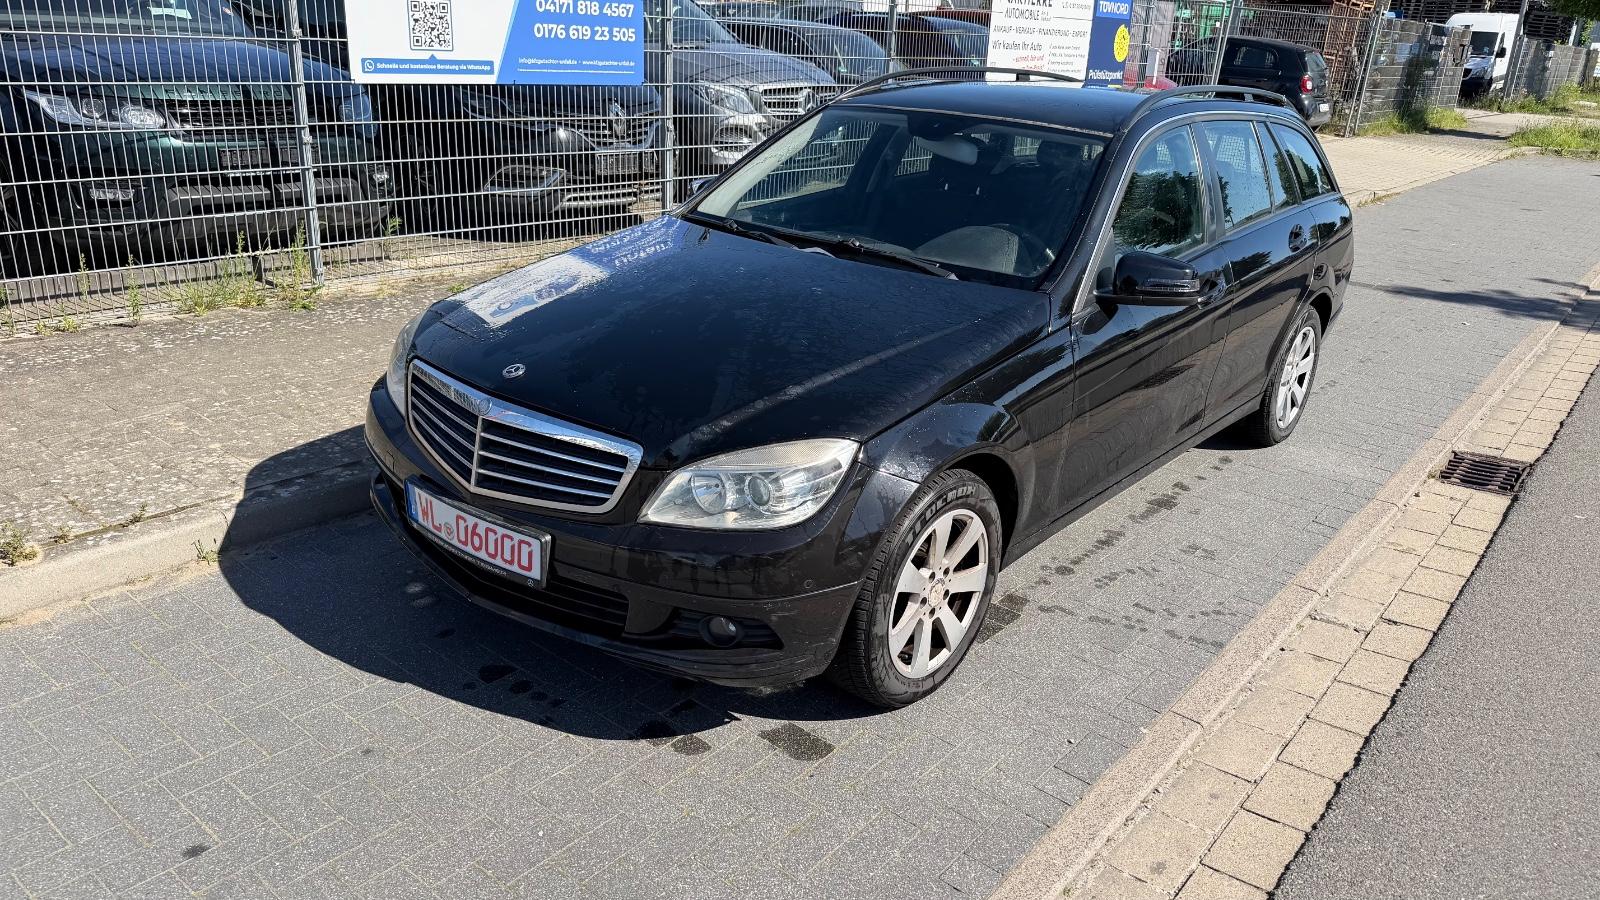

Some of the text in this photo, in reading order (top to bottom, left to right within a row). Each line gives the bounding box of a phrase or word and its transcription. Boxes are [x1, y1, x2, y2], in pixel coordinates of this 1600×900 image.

[536, 0, 634, 18] 04171 818 4567
[1004, 8, 1040, 20] AUTOMOBILE
[534, 22, 636, 42] 0176 619 23 505
[992, 25, 1012, 33] ANKAUF
[1016, 26, 1036, 34] VERKAUF
[992, 40, 1002, 50] Wir
[1002, 41, 1020, 50] kaufen
[1030, 42, 1042, 51] Auto
[418, 492, 442, 532] WL
[456, 514, 533, 572] 06000
